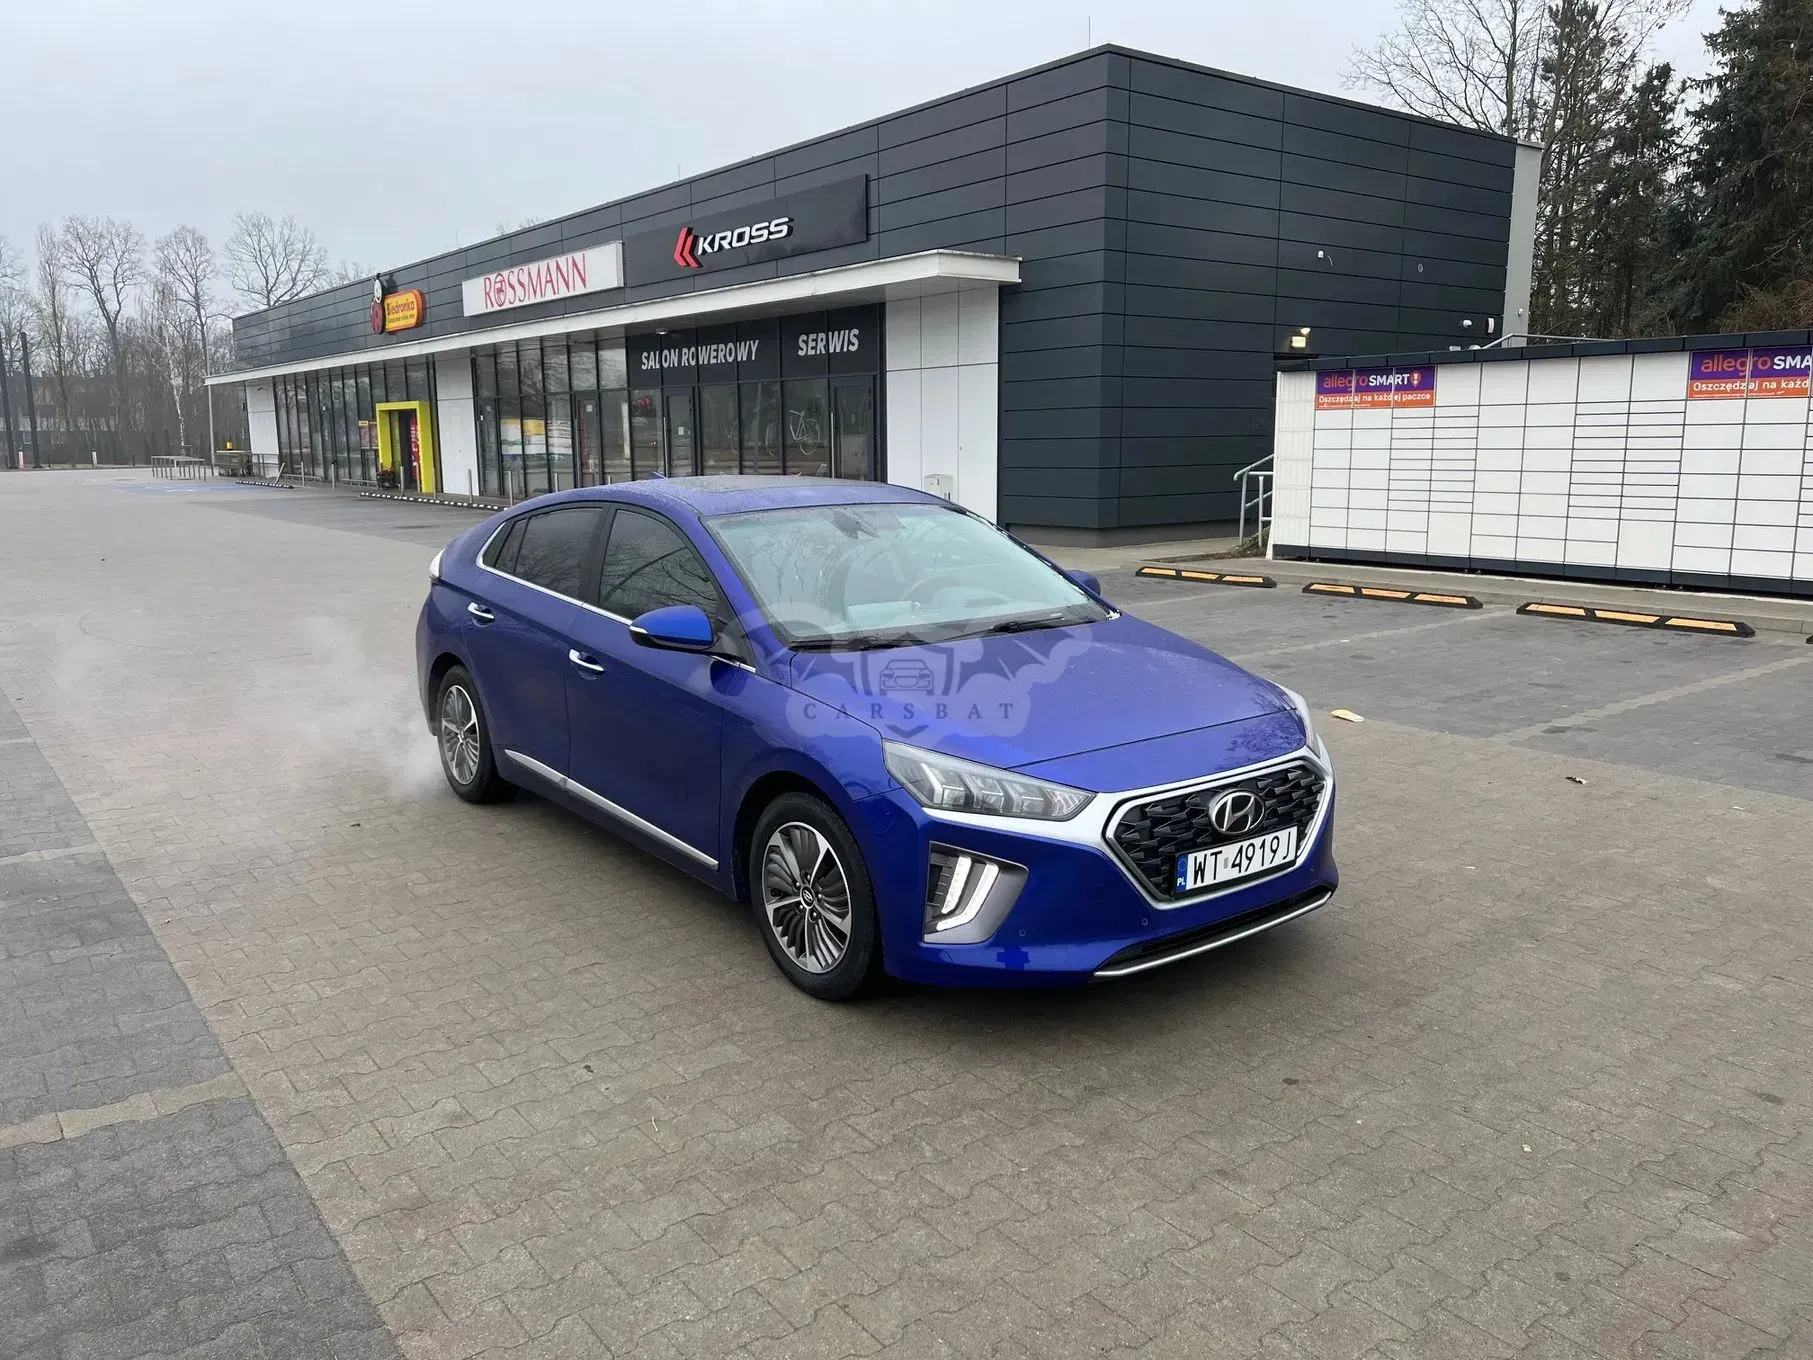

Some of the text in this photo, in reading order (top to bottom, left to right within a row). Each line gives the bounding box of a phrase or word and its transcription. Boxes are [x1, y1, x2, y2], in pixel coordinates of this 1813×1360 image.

[697, 217, 791, 255] KROSS
[483, 252, 588, 310] ROSSMANN
[641, 340, 760, 370] SALON ROWEROWY
[797, 328, 860, 356] SERWIS
[1701, 353, 1770, 376] allegro
[1402, 393, 1431, 403] paczce
[1693, 380, 1759, 392] Oszczędzaj
[1762, 381, 1777, 389] na
[1193, 831, 1292, 885] WT 4919J
[1176, 877, 1186, 887] PL
